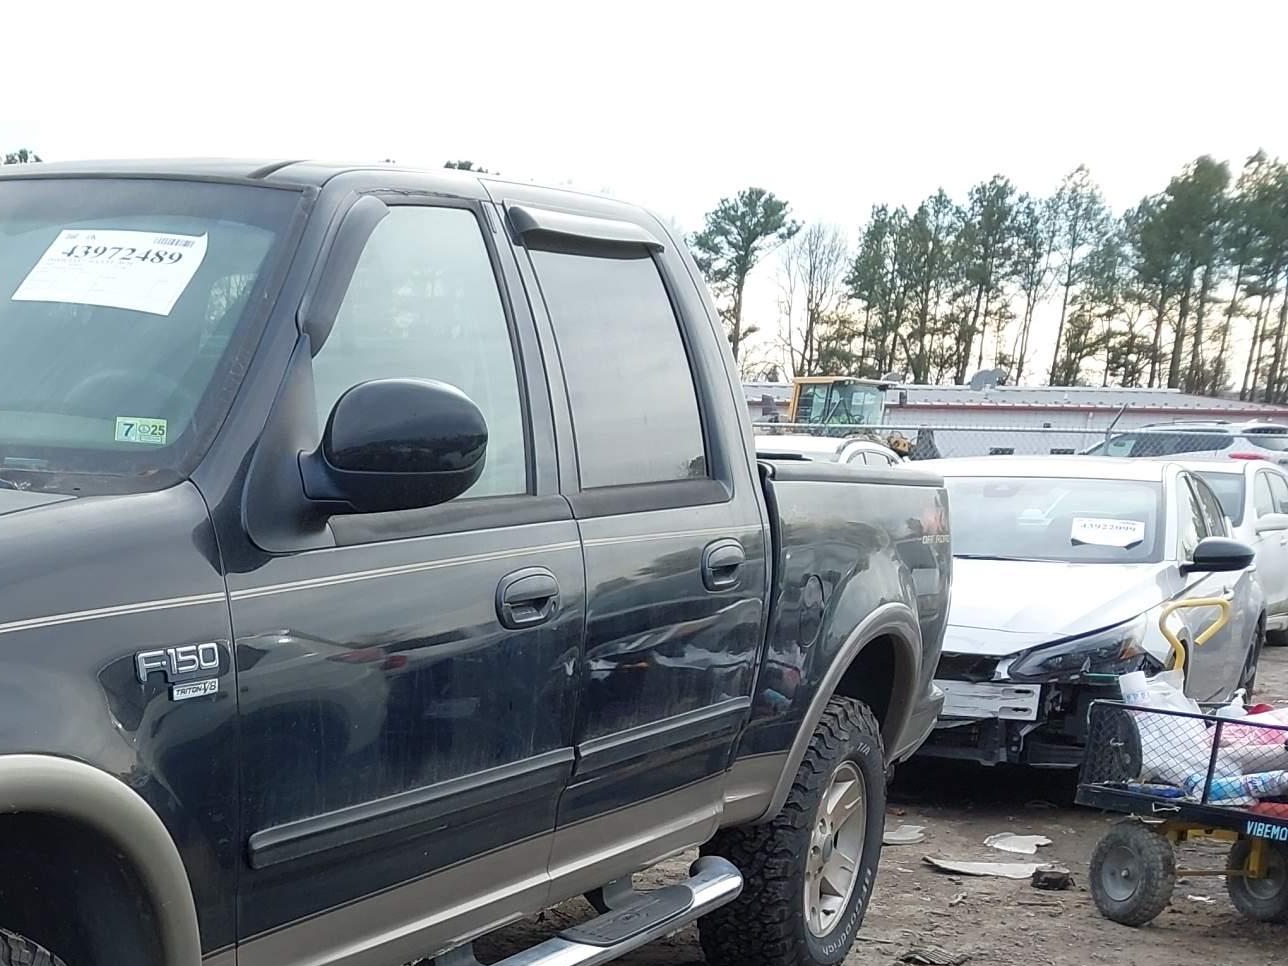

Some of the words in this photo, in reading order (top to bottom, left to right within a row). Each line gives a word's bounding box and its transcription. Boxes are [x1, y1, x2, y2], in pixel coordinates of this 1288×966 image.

[62, 244, 184, 265] 43972489
[123, 423, 135, 437] 7
[150, 424, 166, 437] 25
[1246, 820, 1288, 841] VIBEMO
